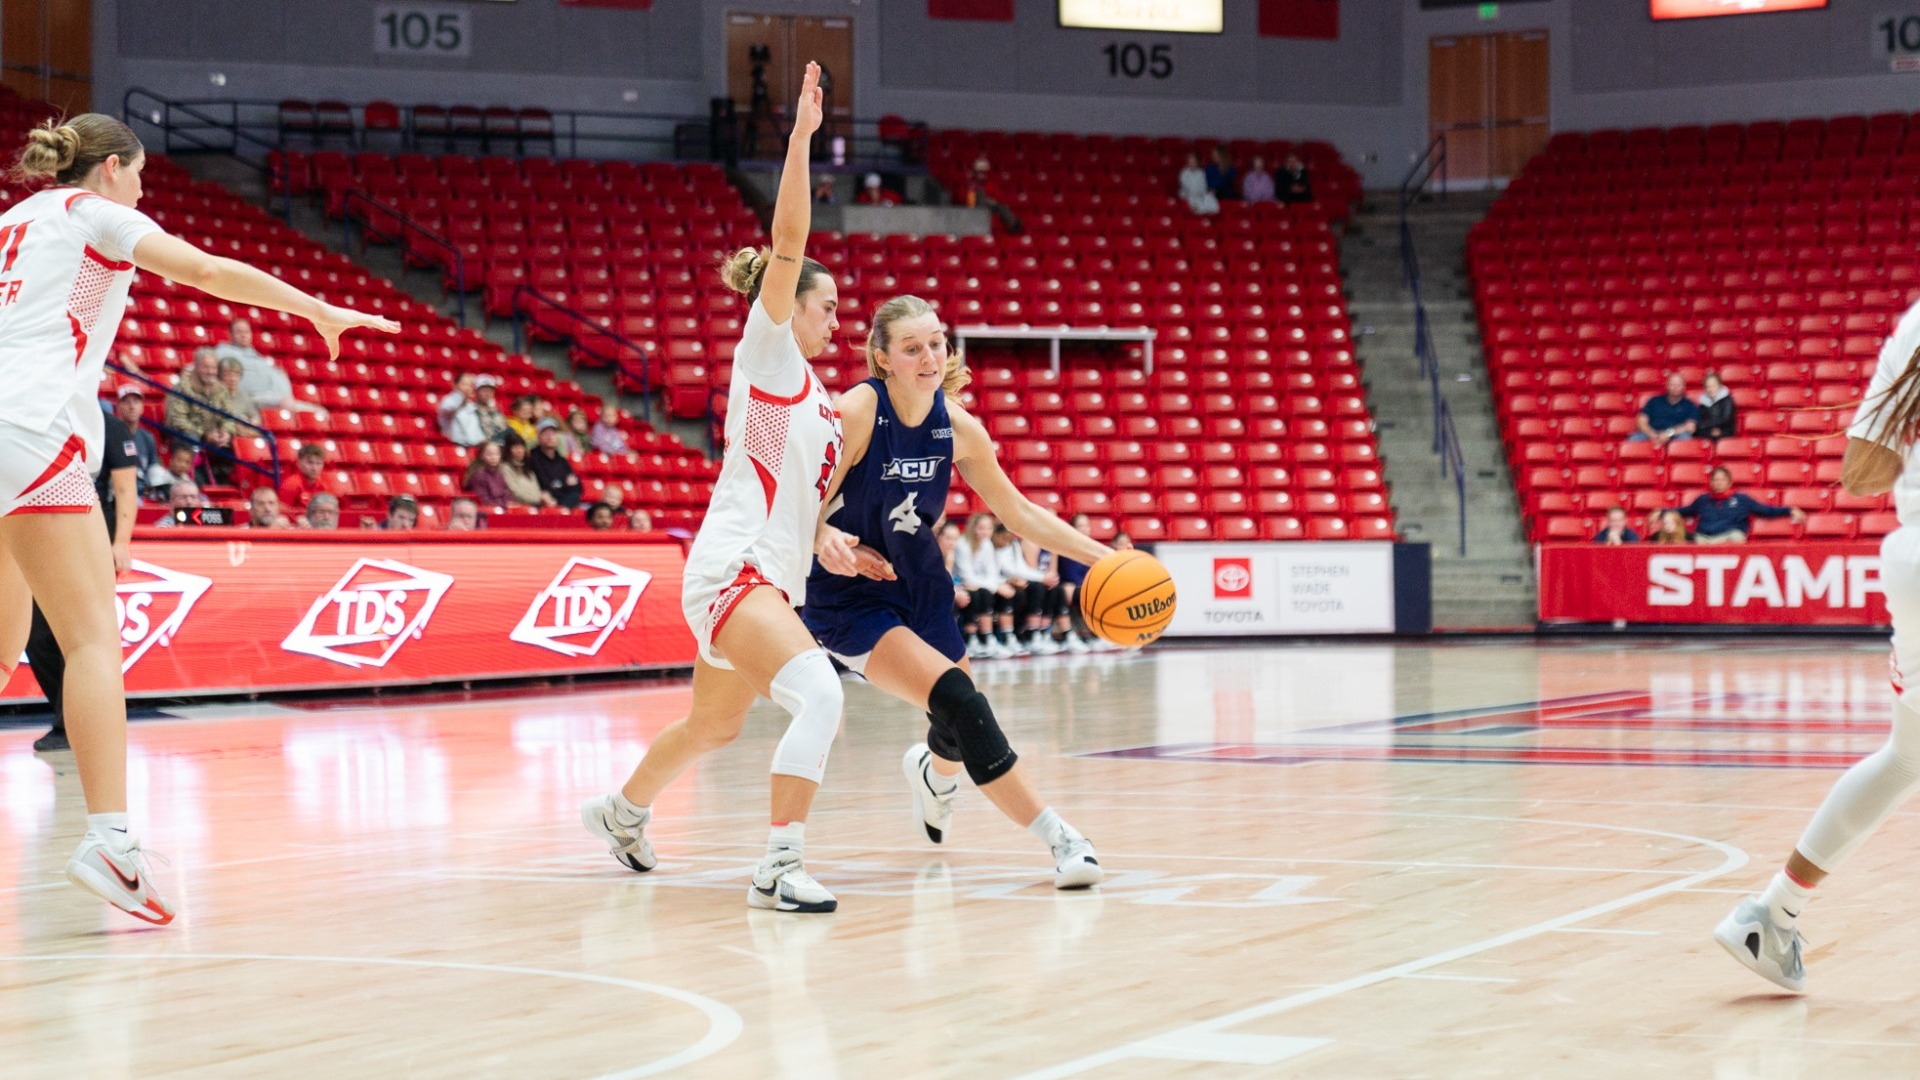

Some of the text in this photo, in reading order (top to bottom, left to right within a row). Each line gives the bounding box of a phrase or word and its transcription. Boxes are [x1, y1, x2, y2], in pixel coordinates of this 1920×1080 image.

[381, 12, 461, 50] 105
[1104, 42, 1173, 79] 105
[883, 457, 942, 482] ACU
[1290, 565, 1349, 578] STEPHEN
[1291, 583, 1331, 596] WADE
[333, 588, 408, 636] TDS
[550, 585, 613, 628] TDS
[1204, 610, 1264, 623] TOYOTA
[1291, 600, 1344, 613] TOYOTA
